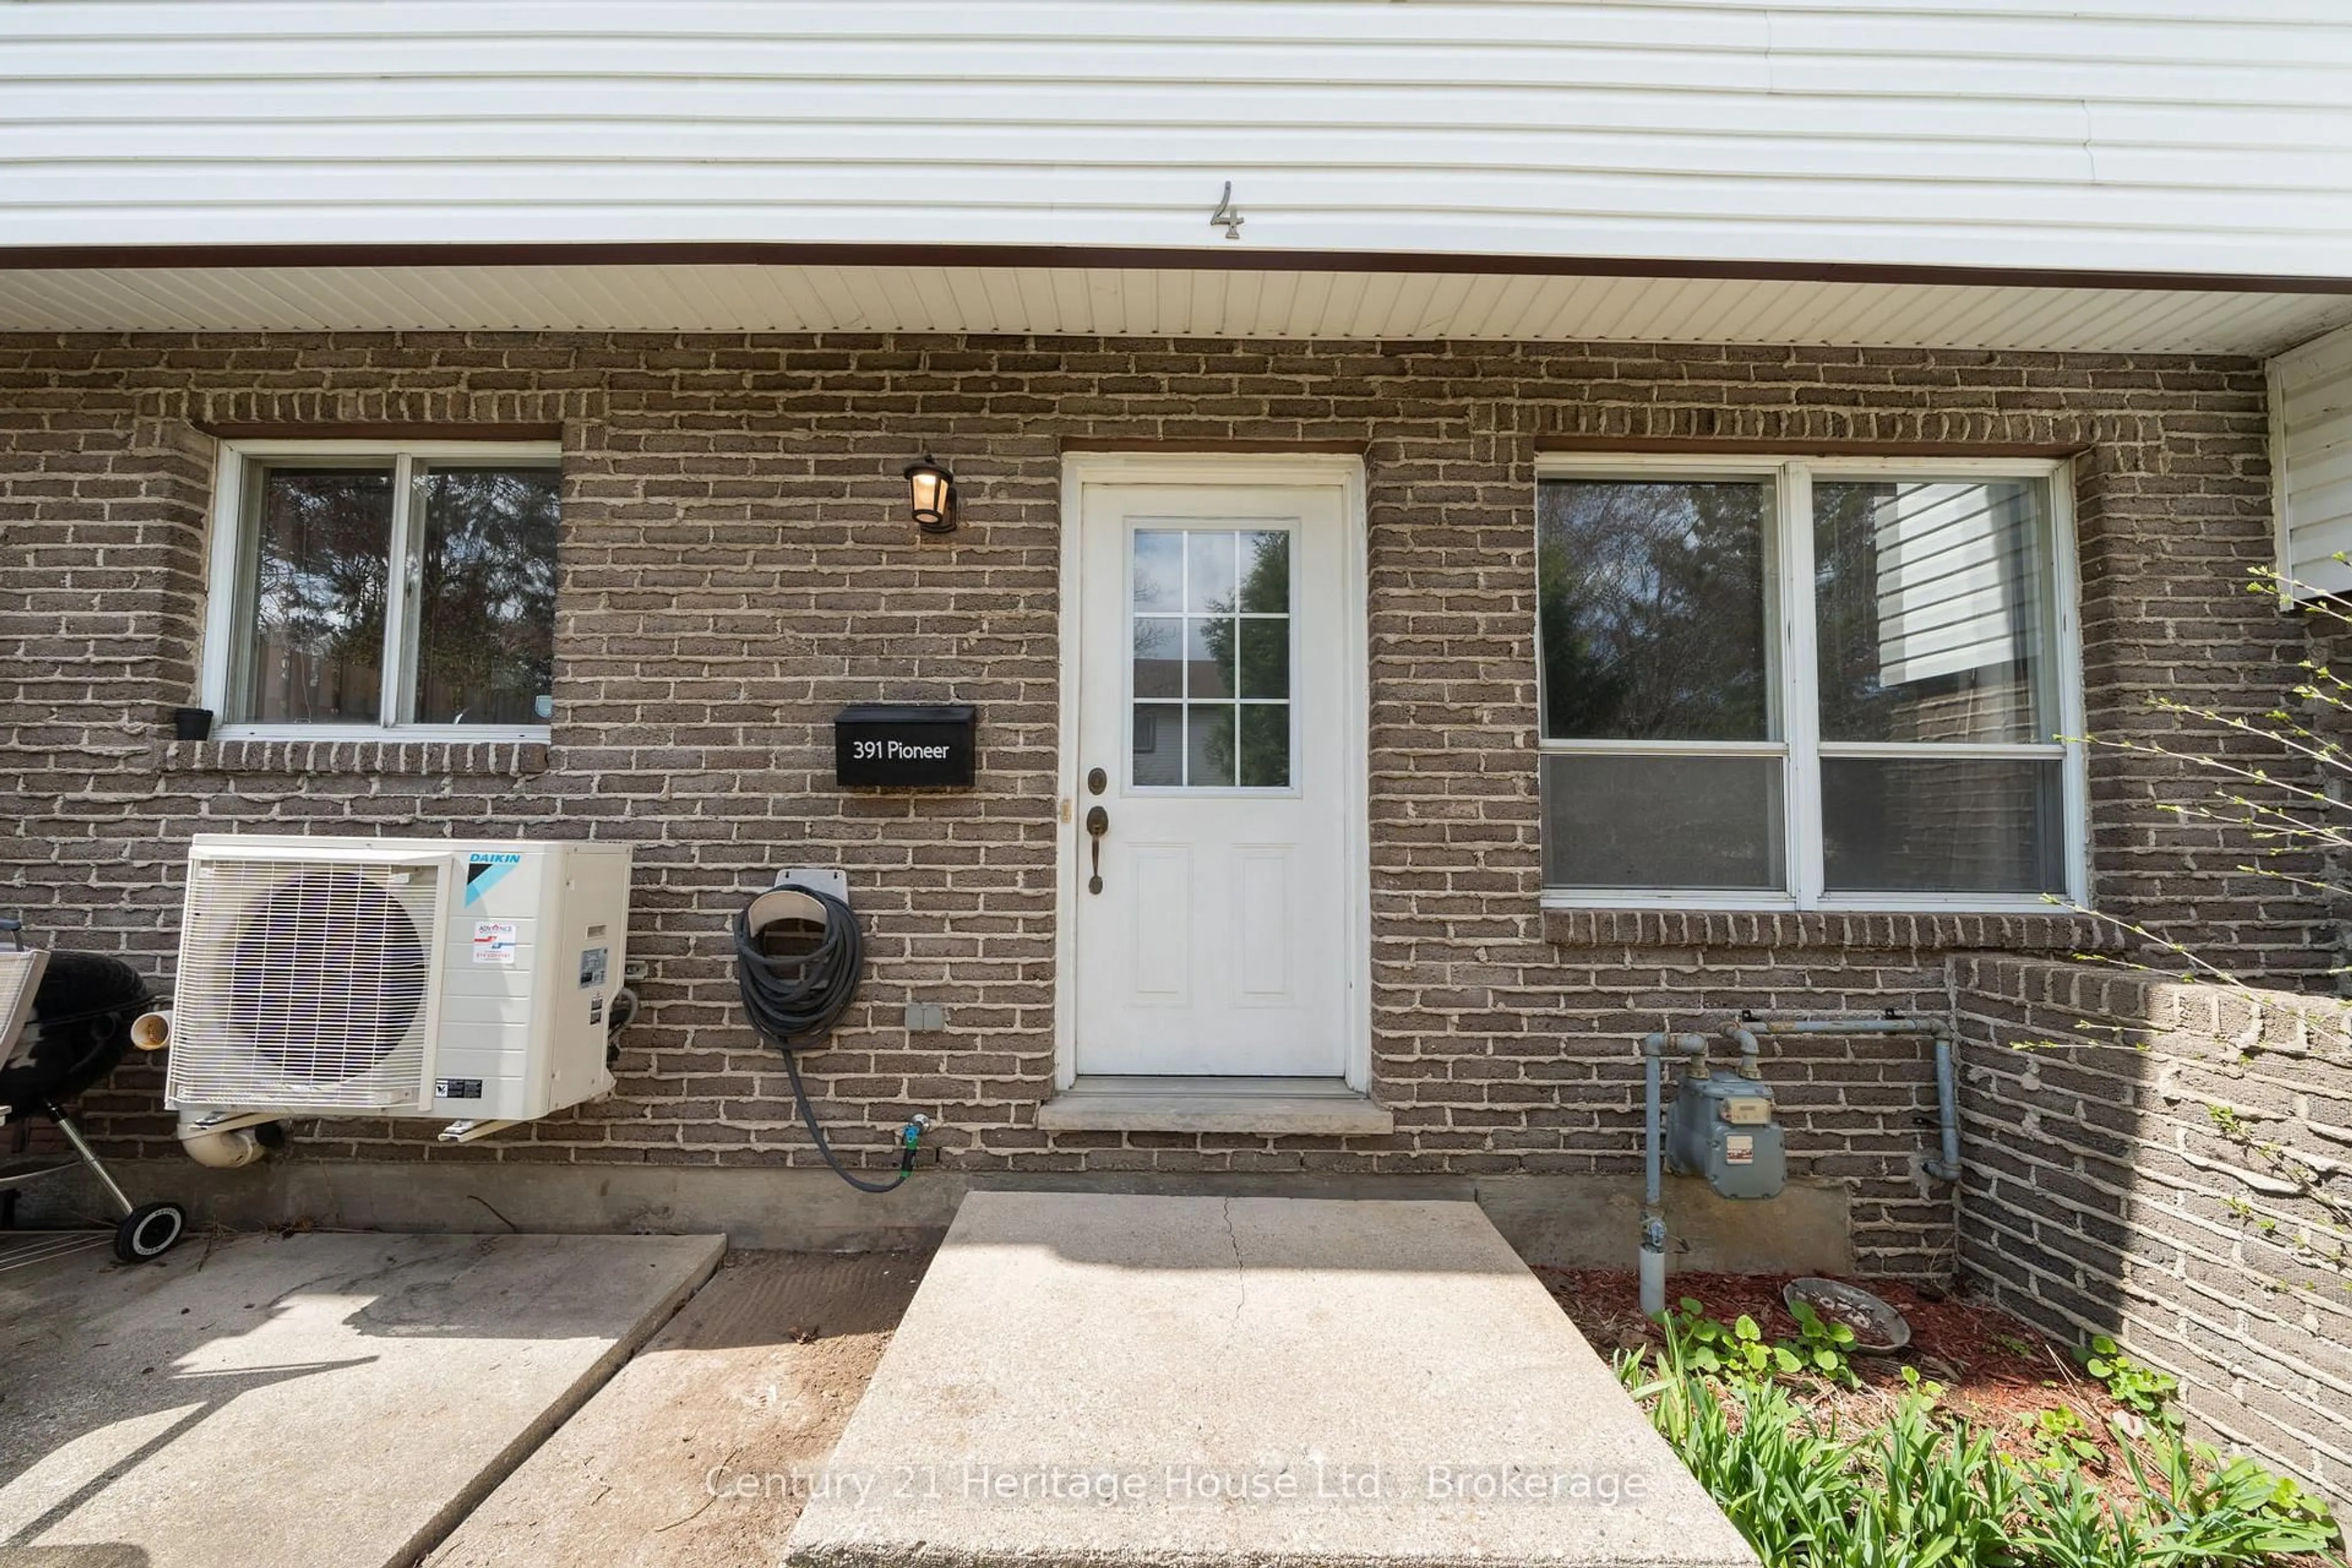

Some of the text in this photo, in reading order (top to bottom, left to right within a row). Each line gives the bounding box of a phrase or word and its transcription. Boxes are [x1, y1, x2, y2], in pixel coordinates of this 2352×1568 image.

[1210, 181, 1245, 239] 4
[853, 741, 949, 759] 391 Pioneer
[470, 853, 521, 863] DAIKIN
